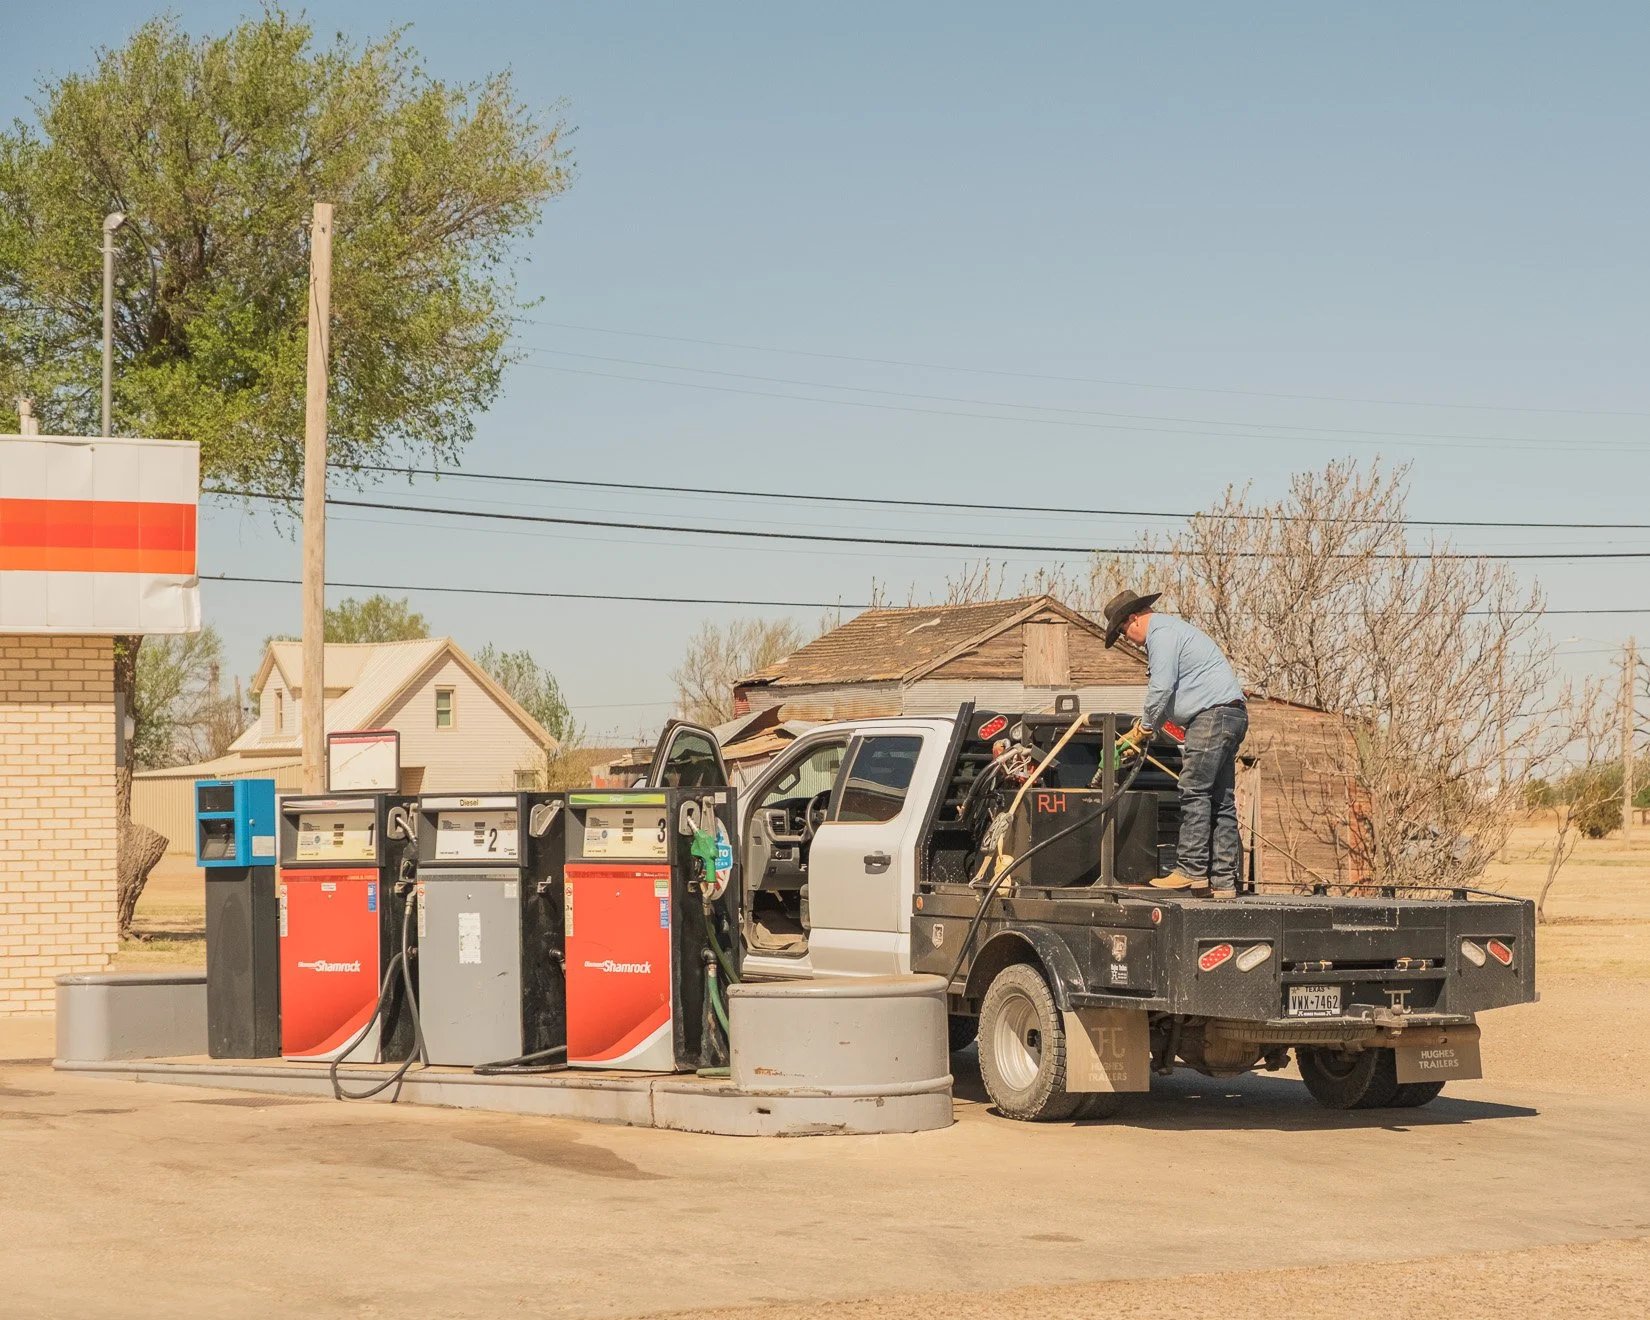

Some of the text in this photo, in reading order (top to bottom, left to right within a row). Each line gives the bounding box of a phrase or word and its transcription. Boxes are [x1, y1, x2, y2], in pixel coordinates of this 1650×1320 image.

[460, 799, 479, 807] Diesel
[368, 823, 375, 846] 1
[657, 818, 667, 843] 3
[488, 828, 498, 852] 2
[315, 960, 361, 972] Shamrock
[603, 960, 651, 973] Shamrock
[1421, 1049, 1455, 1059] HUGHES
[1418, 1059, 1459, 1069] TRAILERS
